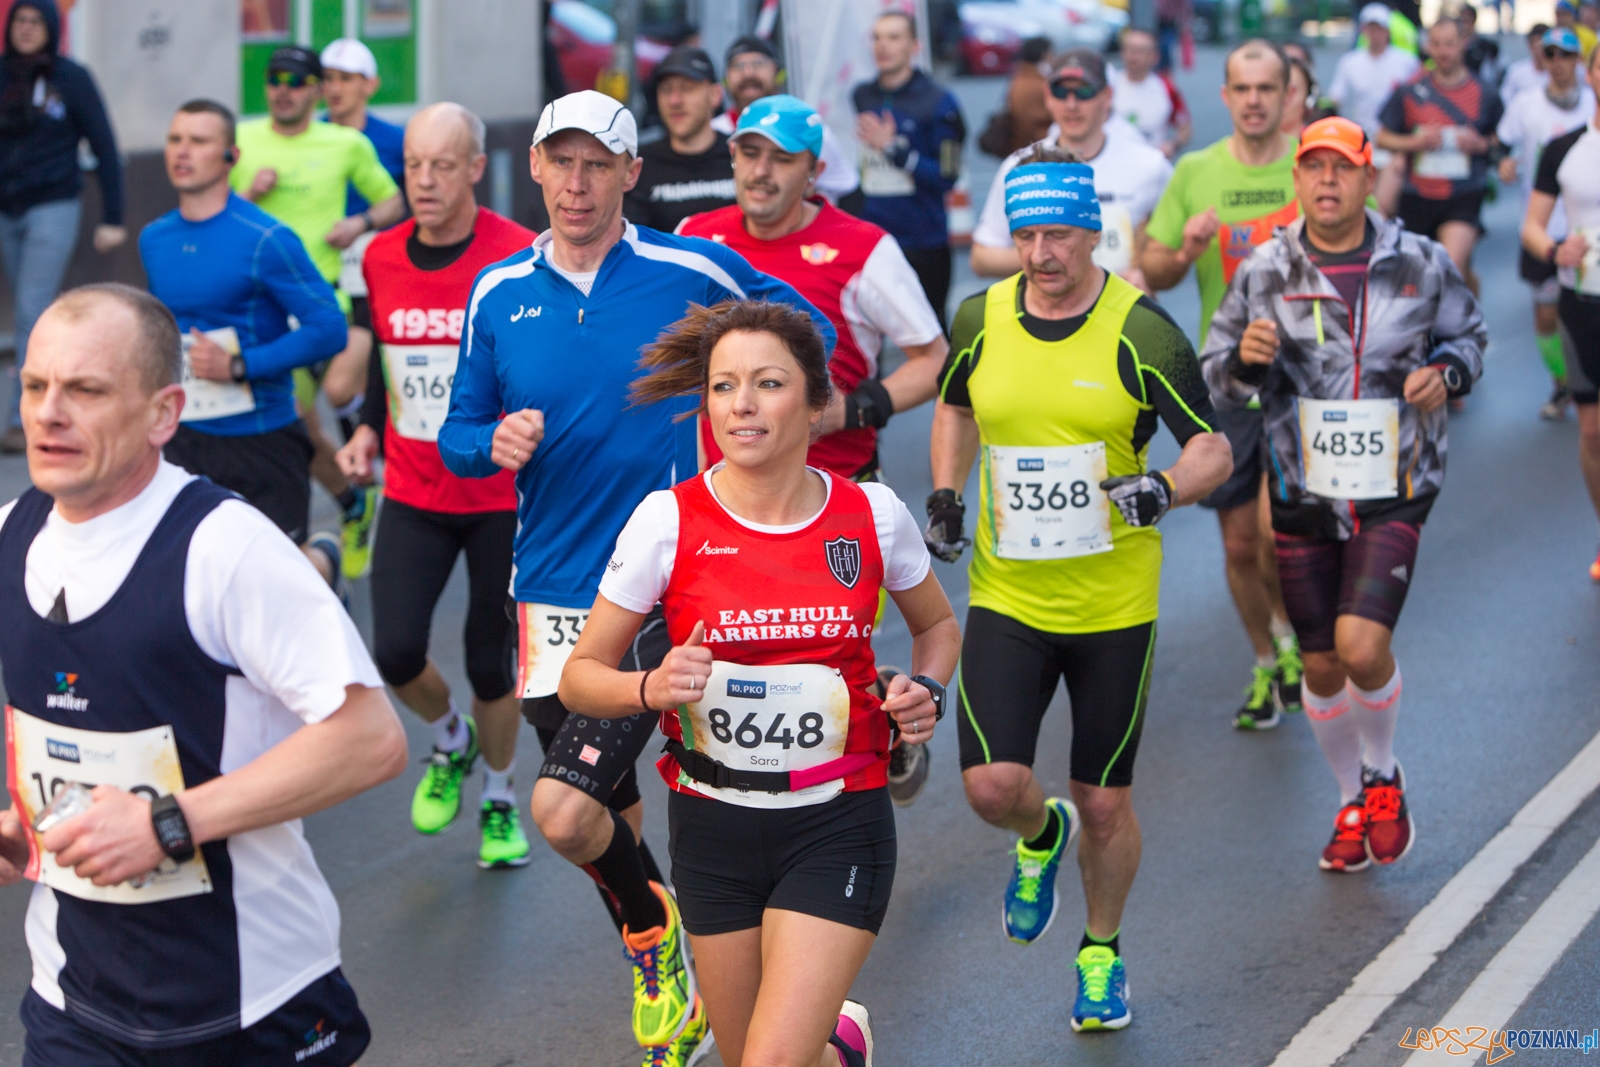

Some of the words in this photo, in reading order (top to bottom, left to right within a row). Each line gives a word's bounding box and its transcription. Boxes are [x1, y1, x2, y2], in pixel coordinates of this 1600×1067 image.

[1020, 188, 1079, 200] BROOKS
[1312, 430, 1384, 456] 4835
[1007, 480, 1090, 511] 3368
[704, 545, 740, 556] Scimitar
[718, 609, 785, 626] EAST
[789, 606, 854, 622] HULL
[821, 624, 841, 637] &
[844, 624, 859, 638] A
[730, 684, 743, 693] 10.
[743, 685, 764, 694] PKO
[46, 693, 90, 712] walker
[708, 707, 824, 749] 8648
[750, 755, 779, 766] Sara
